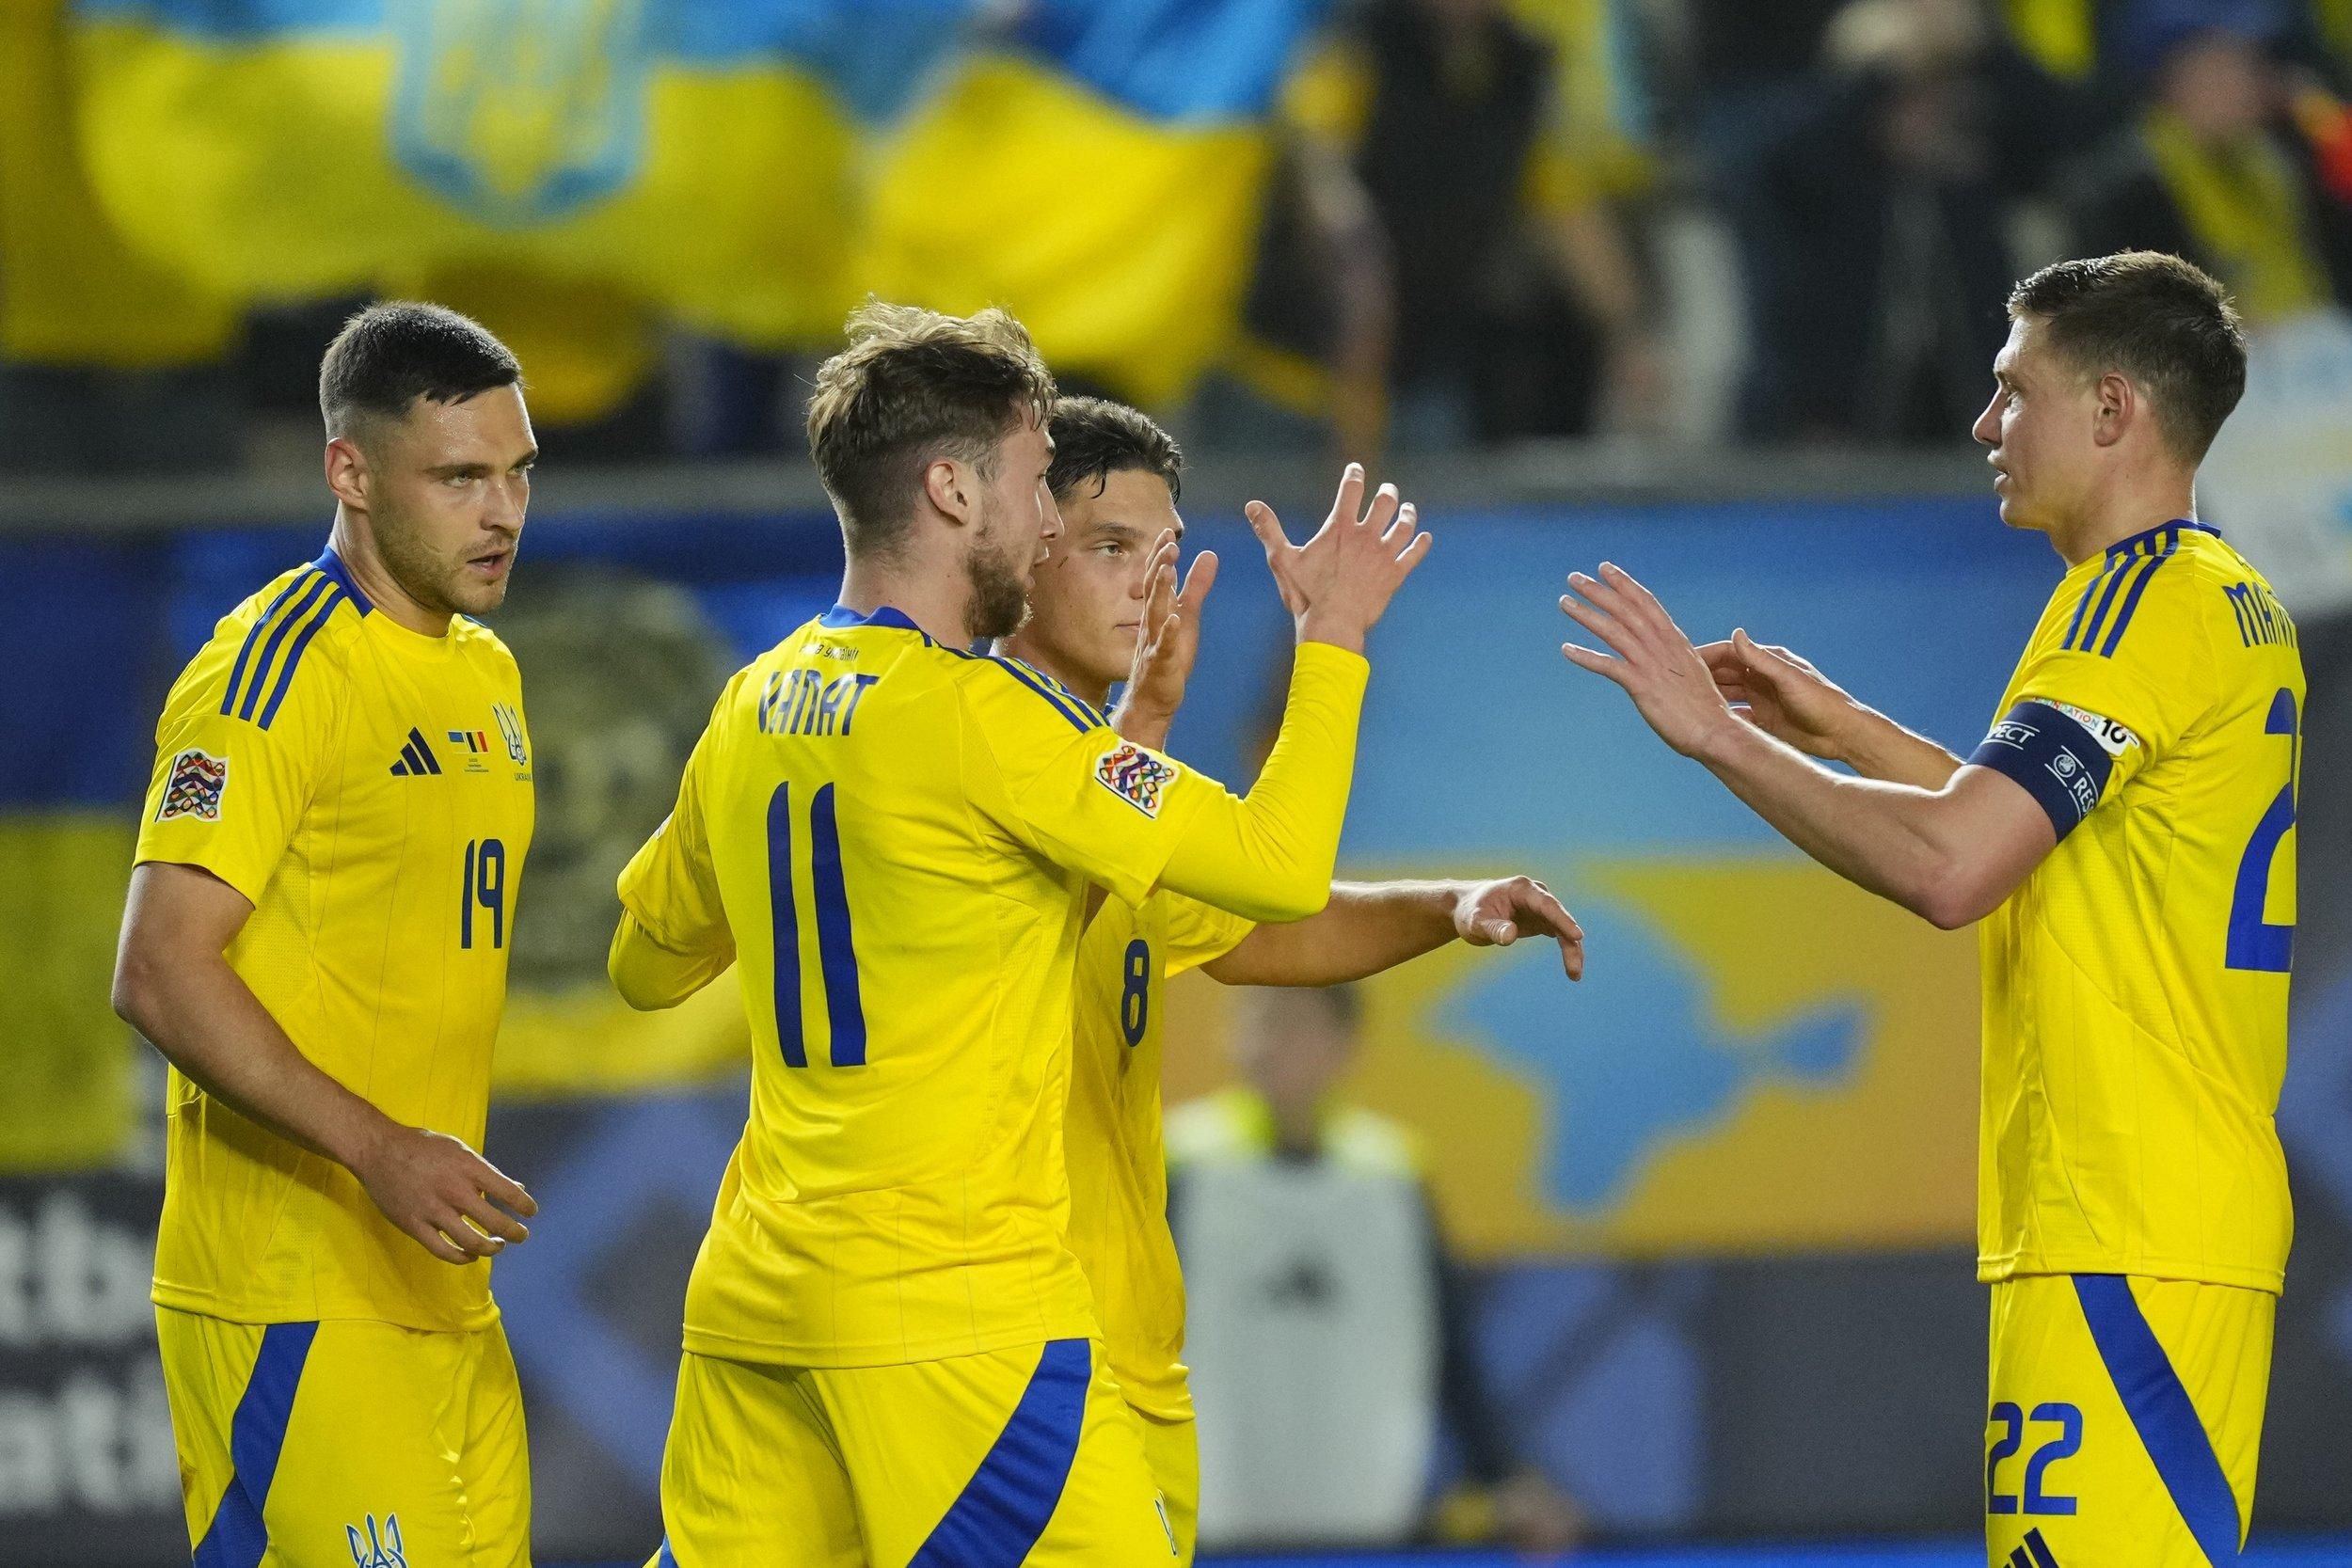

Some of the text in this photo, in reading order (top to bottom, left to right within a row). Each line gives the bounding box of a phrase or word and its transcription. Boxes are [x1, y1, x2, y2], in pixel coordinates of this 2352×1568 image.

[2073, 776, 2095, 815] RES
[461, 838, 505, 949] 19
[767, 781, 867, 1069] 11
[1120, 938, 1151, 1048] 8
[1987, 1402, 2084, 1516] 22
